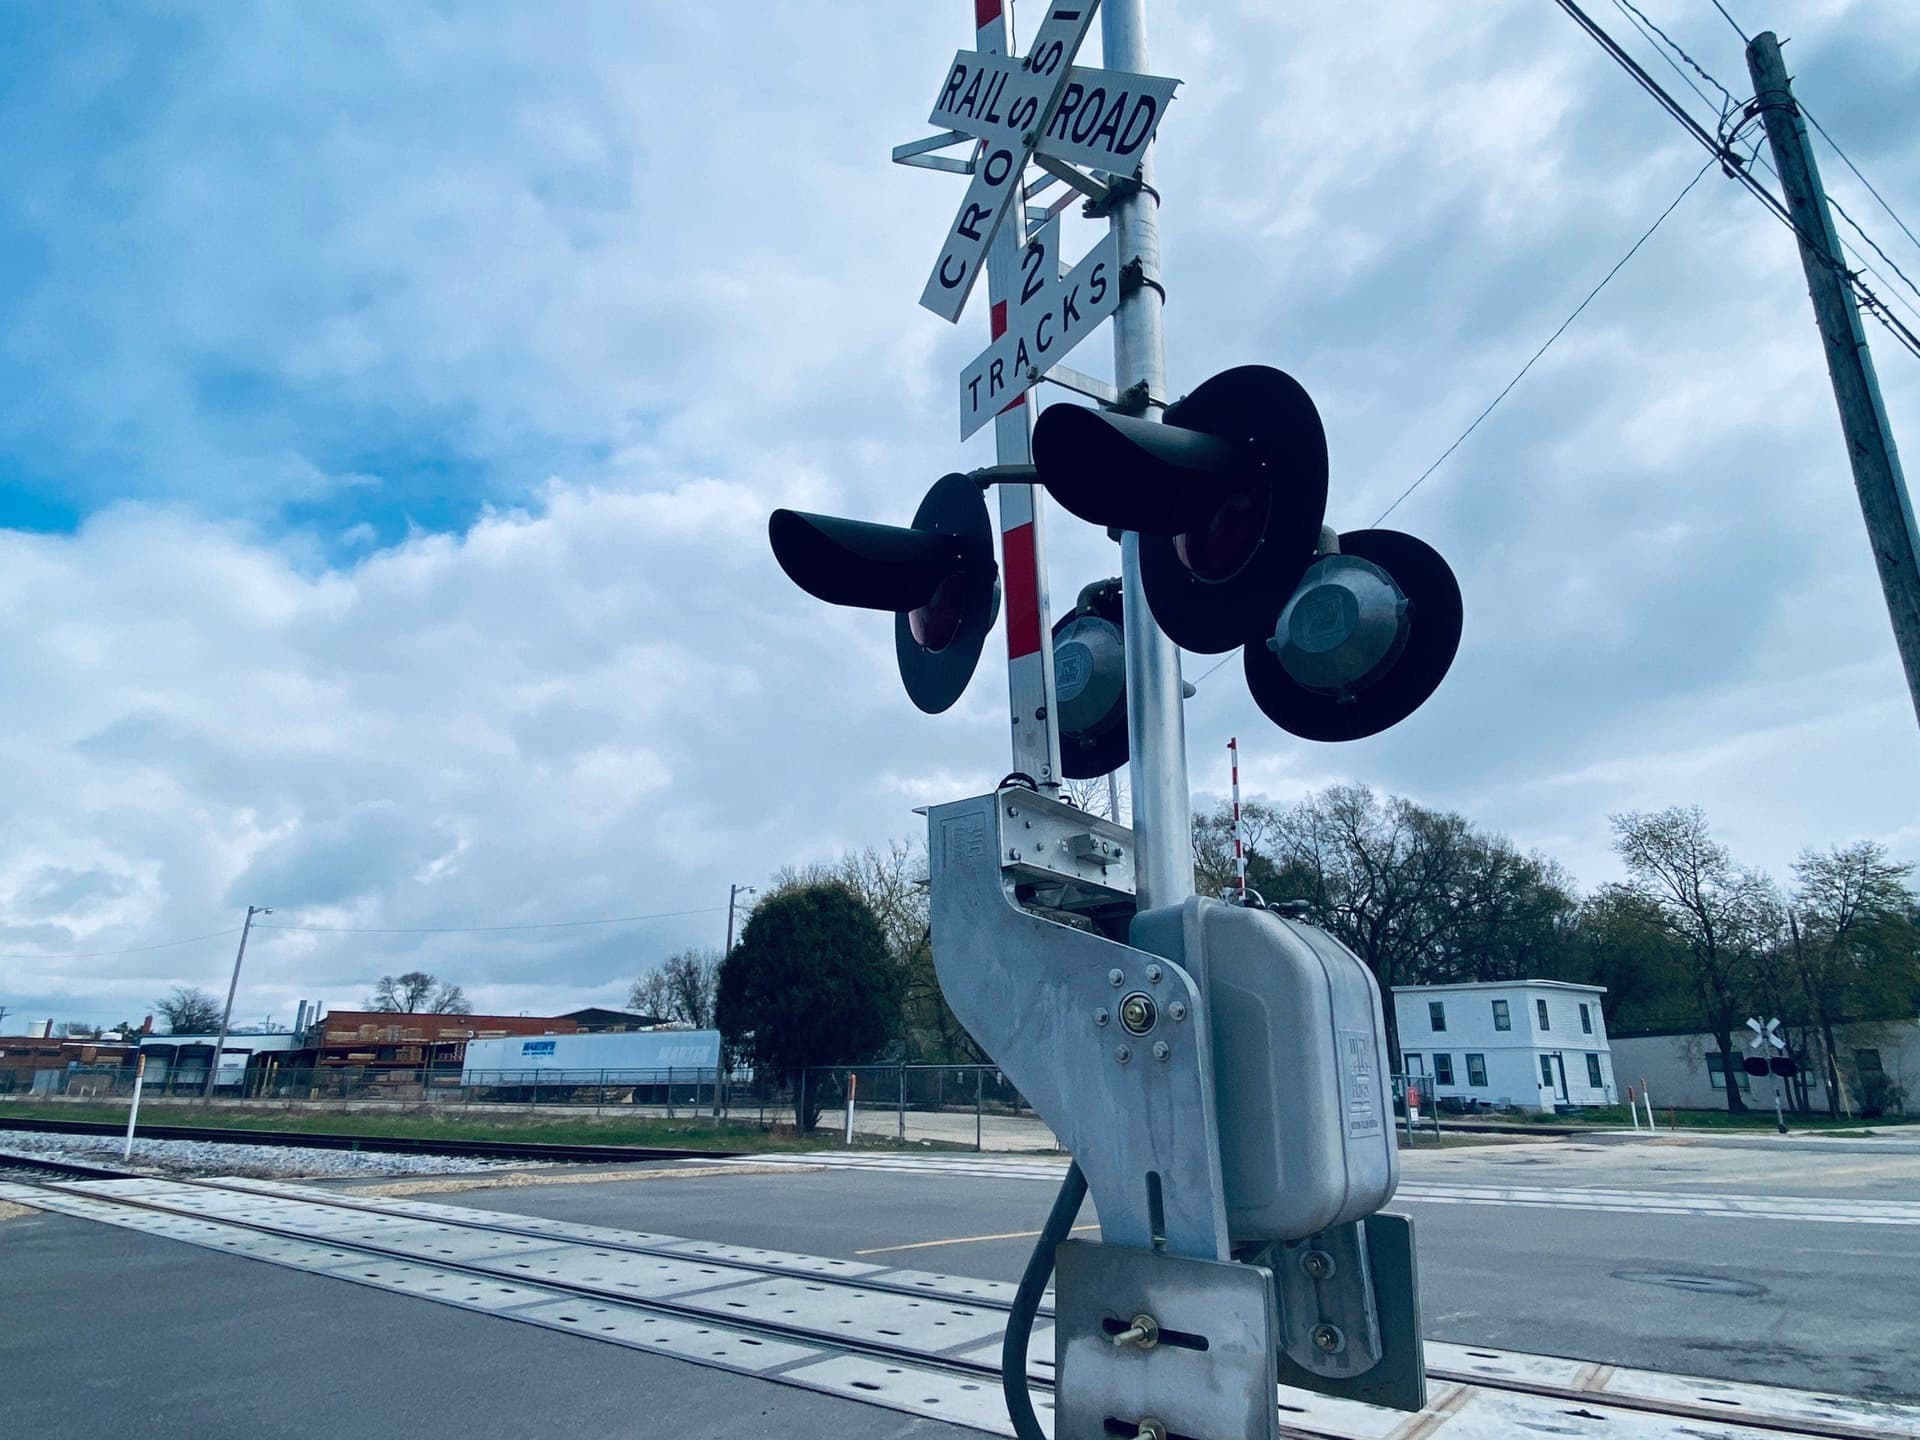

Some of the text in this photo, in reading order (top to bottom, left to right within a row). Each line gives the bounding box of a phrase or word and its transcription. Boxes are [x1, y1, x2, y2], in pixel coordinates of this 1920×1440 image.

[939, 64, 1157, 155] RAIL ROAD
[1020, 243, 1045, 305] 2
[968, 263, 1106, 412] TRACKS
